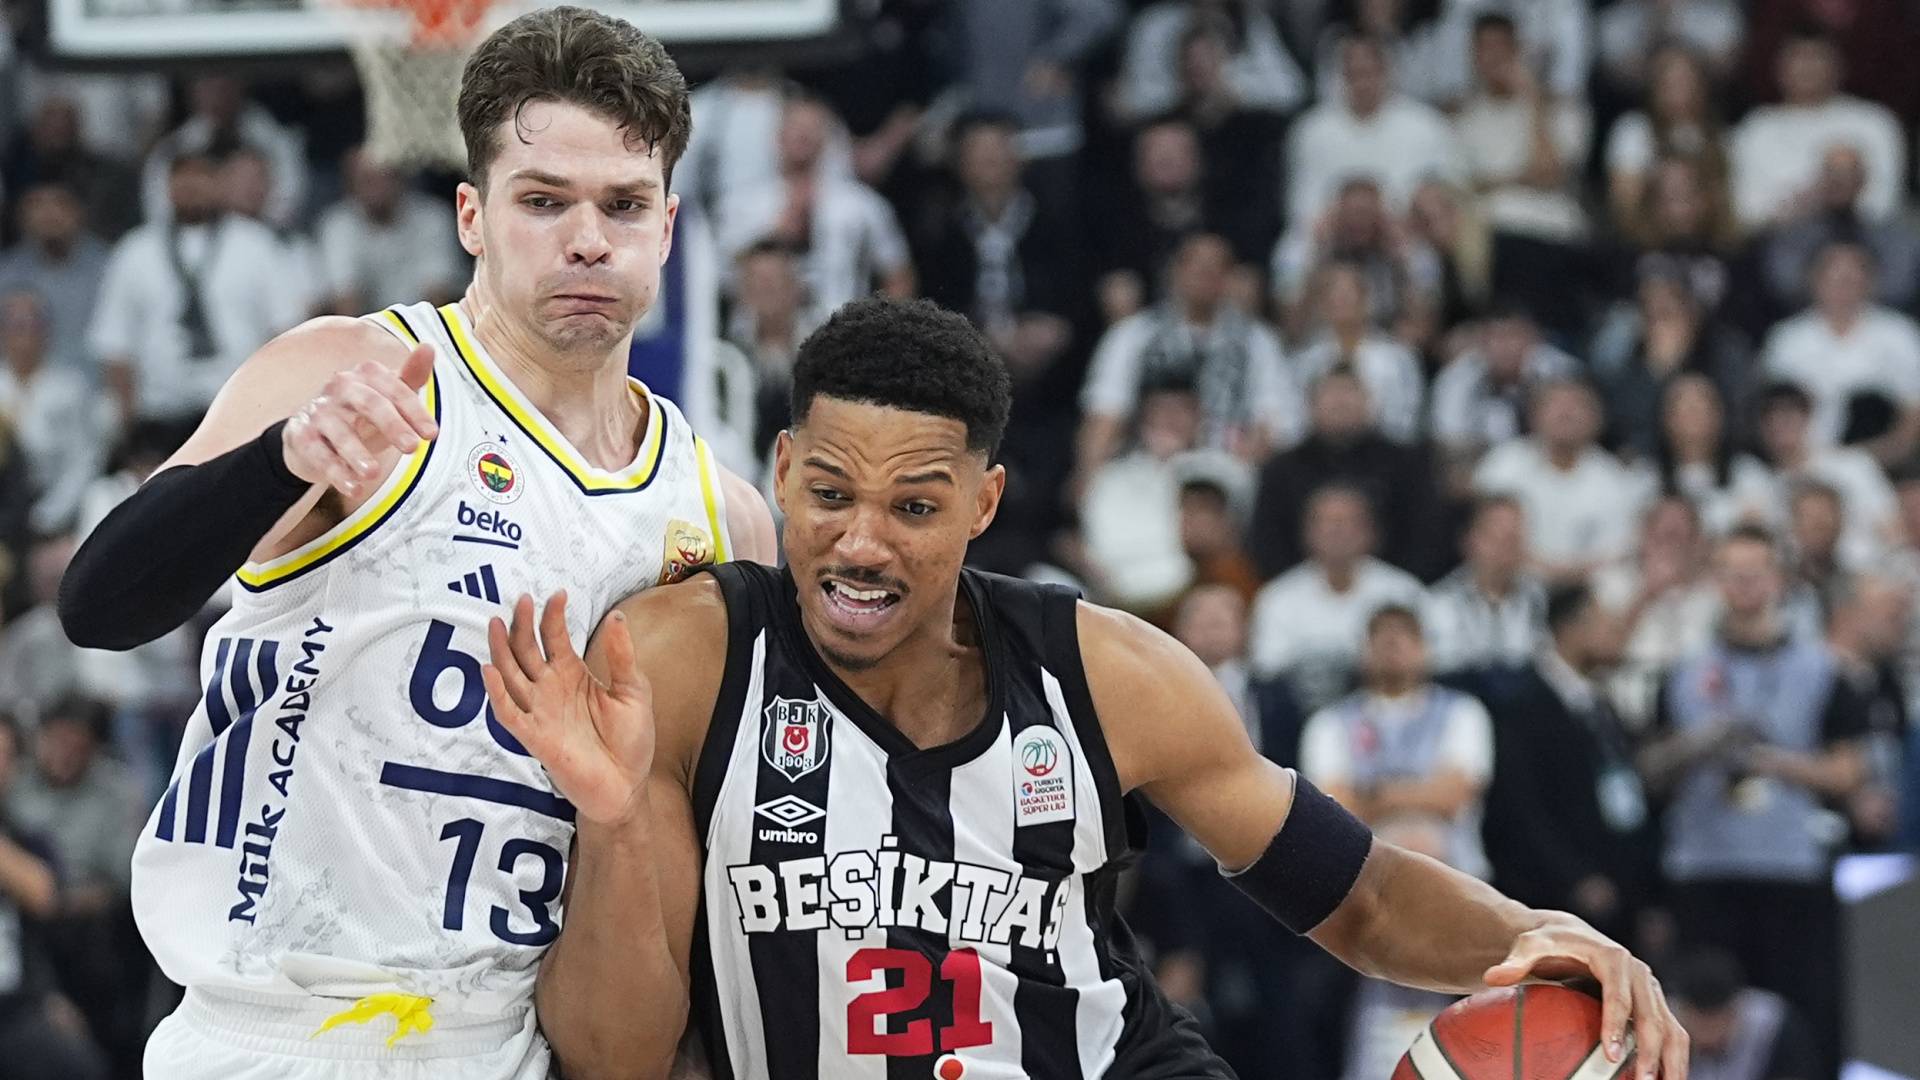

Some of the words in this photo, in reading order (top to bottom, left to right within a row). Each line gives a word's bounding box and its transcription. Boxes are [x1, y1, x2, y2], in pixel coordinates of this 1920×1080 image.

[457, 500, 522, 541] beko
[778, 705, 817, 723] BJK
[229, 804, 286, 926] Milk
[268, 617, 334, 798] ACADEMY
[778, 755, 813, 768] 1903
[758, 828, 818, 844] umbro
[439, 817, 564, 946] 13
[727, 834, 1071, 965] BEŞİKTAŞ
[845, 946, 993, 1057] 21
